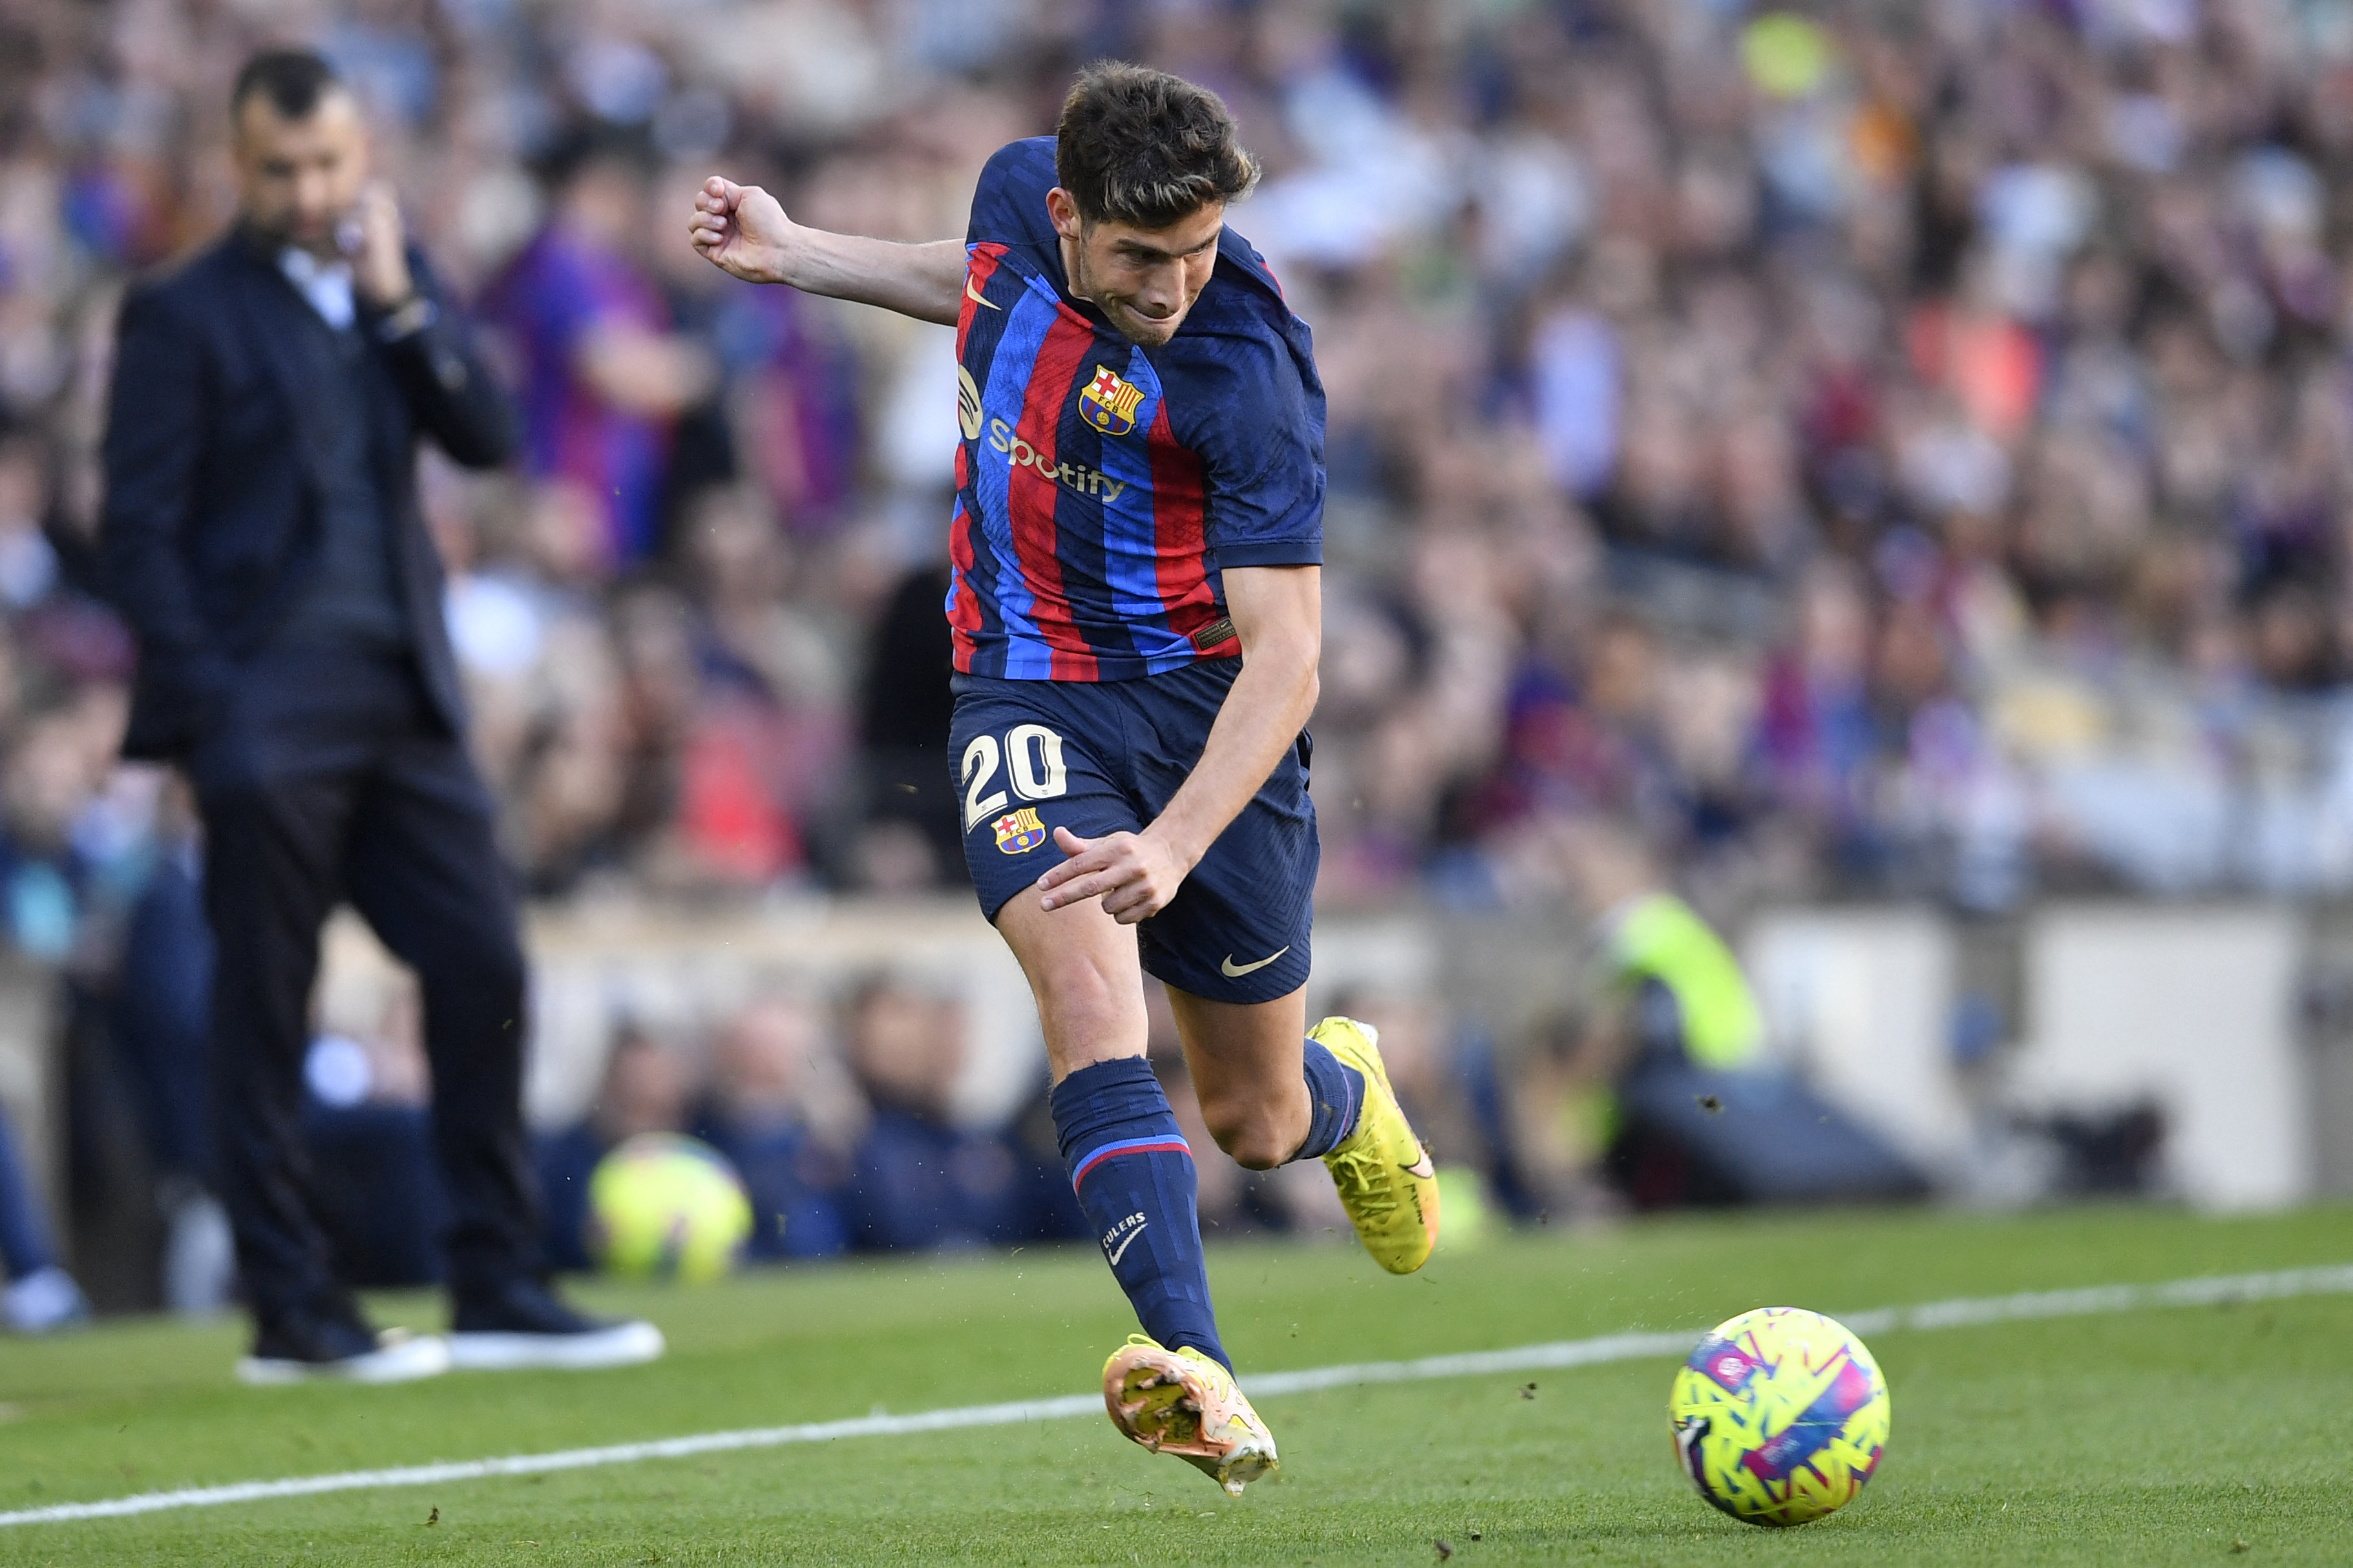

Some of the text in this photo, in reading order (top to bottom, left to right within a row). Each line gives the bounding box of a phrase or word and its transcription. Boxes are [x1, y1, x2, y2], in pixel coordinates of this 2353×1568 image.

[989, 418, 1128, 503] Spotify
[961, 724, 1067, 835] 20
[1103, 1211, 1146, 1249] CULERS
